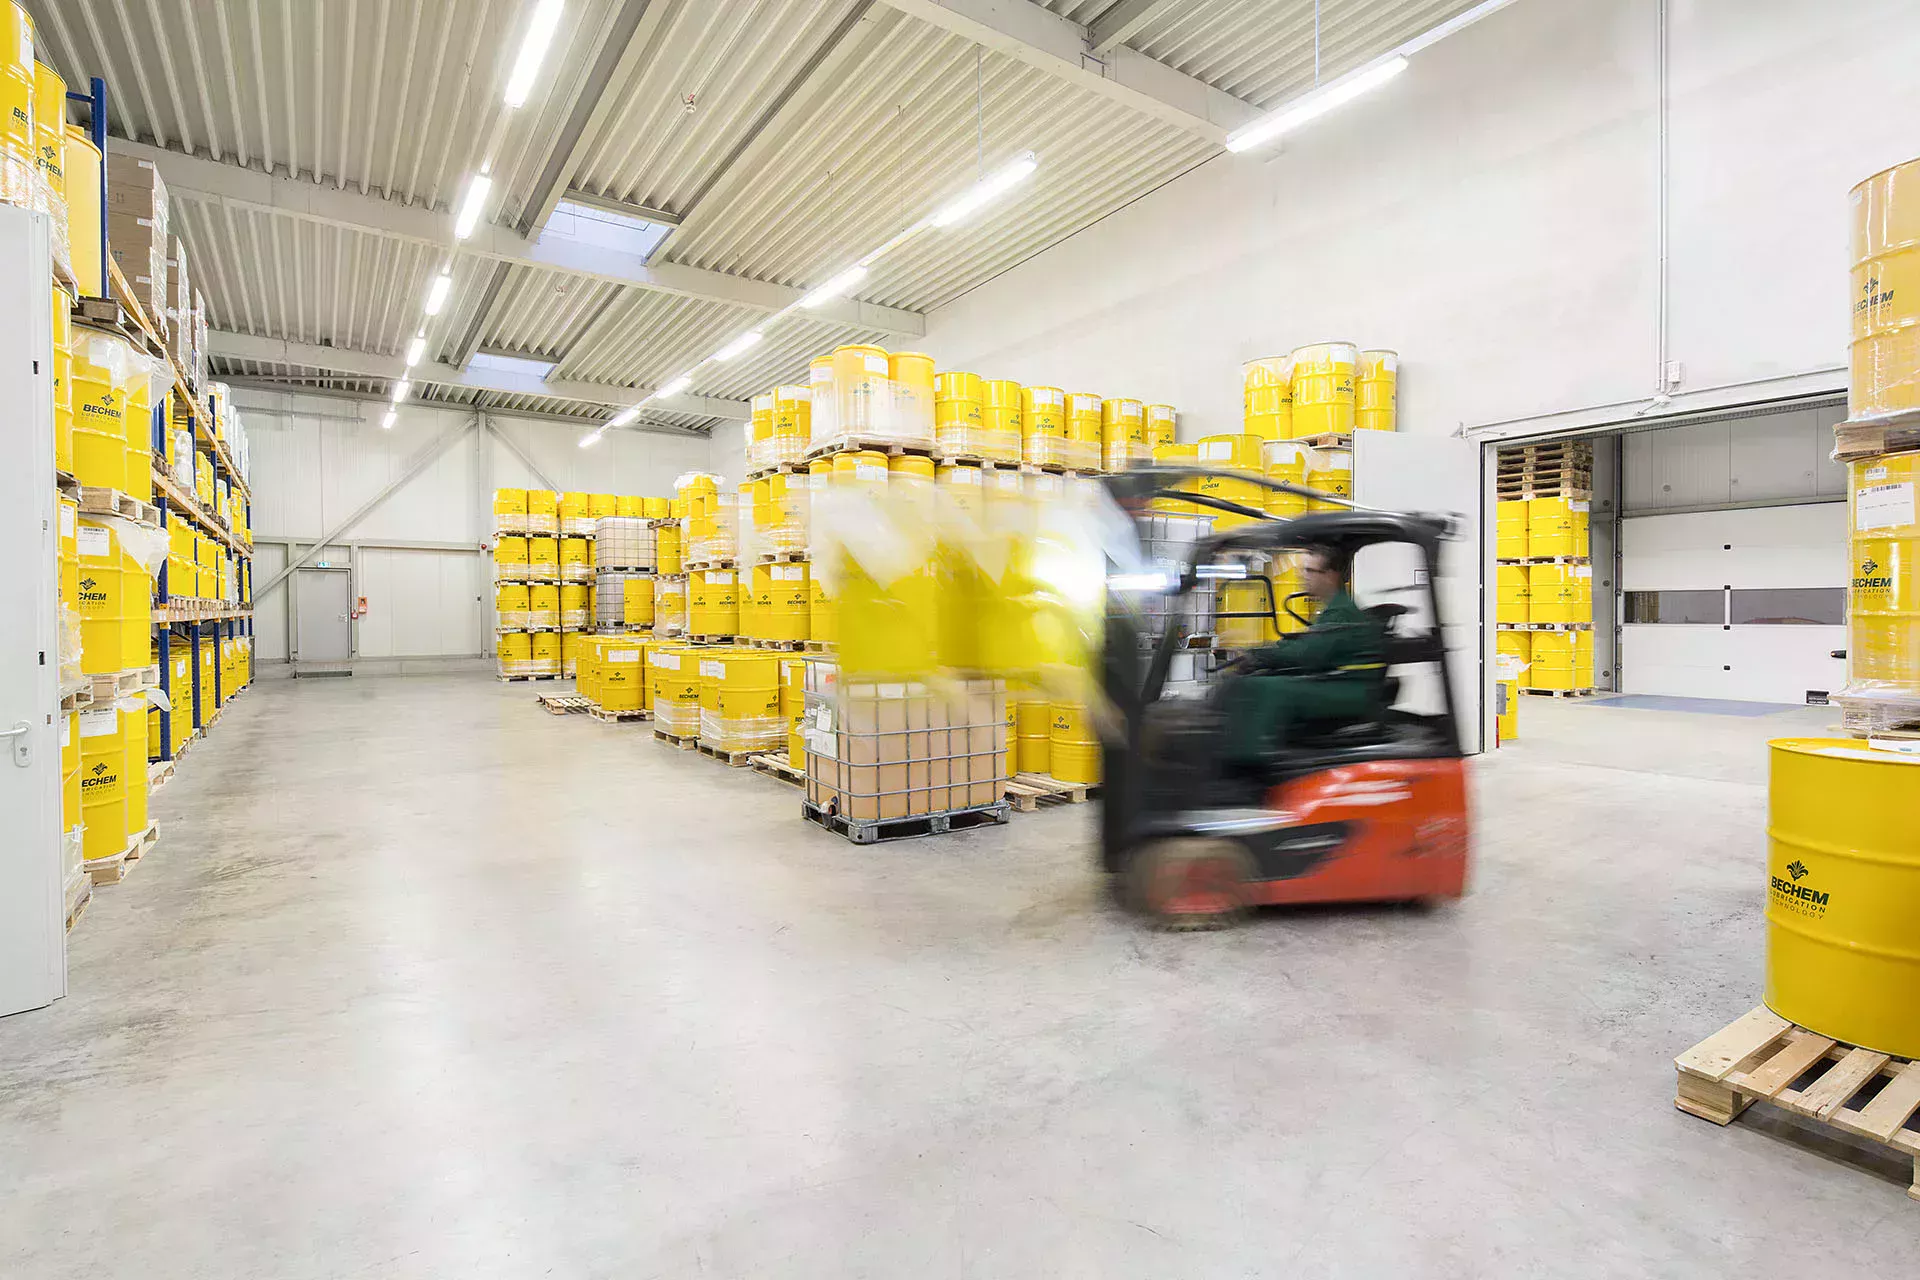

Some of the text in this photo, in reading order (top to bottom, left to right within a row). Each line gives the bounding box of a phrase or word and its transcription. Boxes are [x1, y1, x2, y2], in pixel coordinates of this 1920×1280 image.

[37, 157, 62, 178] CHEM
[83, 404, 122, 418] BECHEM
[1771, 876, 1830, 906] BECHEM
